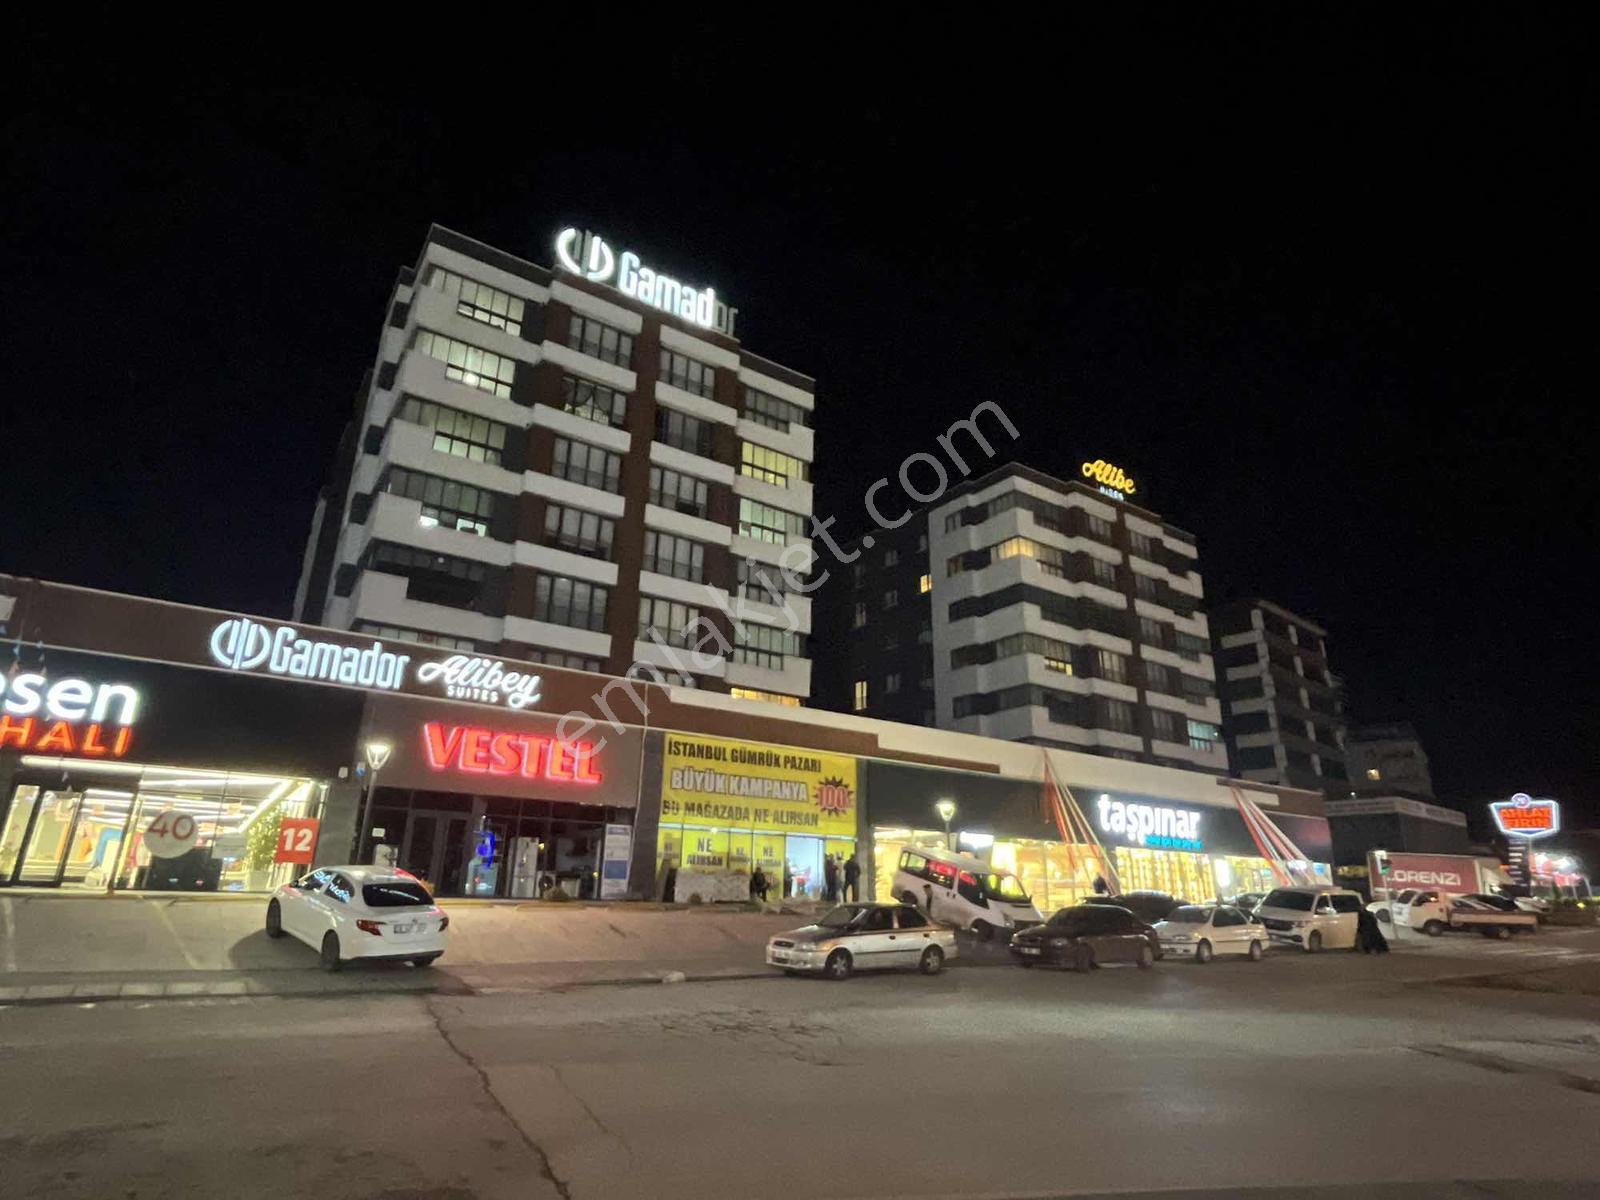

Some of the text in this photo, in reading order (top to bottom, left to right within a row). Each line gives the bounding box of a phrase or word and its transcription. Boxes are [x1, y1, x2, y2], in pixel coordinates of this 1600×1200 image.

[617, 251, 739, 337] Gamador
[269, 625, 410, 690] Gamador
[0, 672, 138, 725] sen
[418, 654, 541, 709] Alibey
[447, 684, 499, 703] SUITES
[424, 721, 604, 784] VESTEL
[668, 737, 821, 773] İSTANBUL GÜMRÜK PAZARI
[671, 766, 809, 803] BÜYÜK KAMPANYA
[149, 814, 195, 841] 40
[754, 808, 769, 824] NE
[1097, 793, 1201, 846] taşpınar
[282, 828, 313, 852] 12
[697, 838, 713, 853] NE
